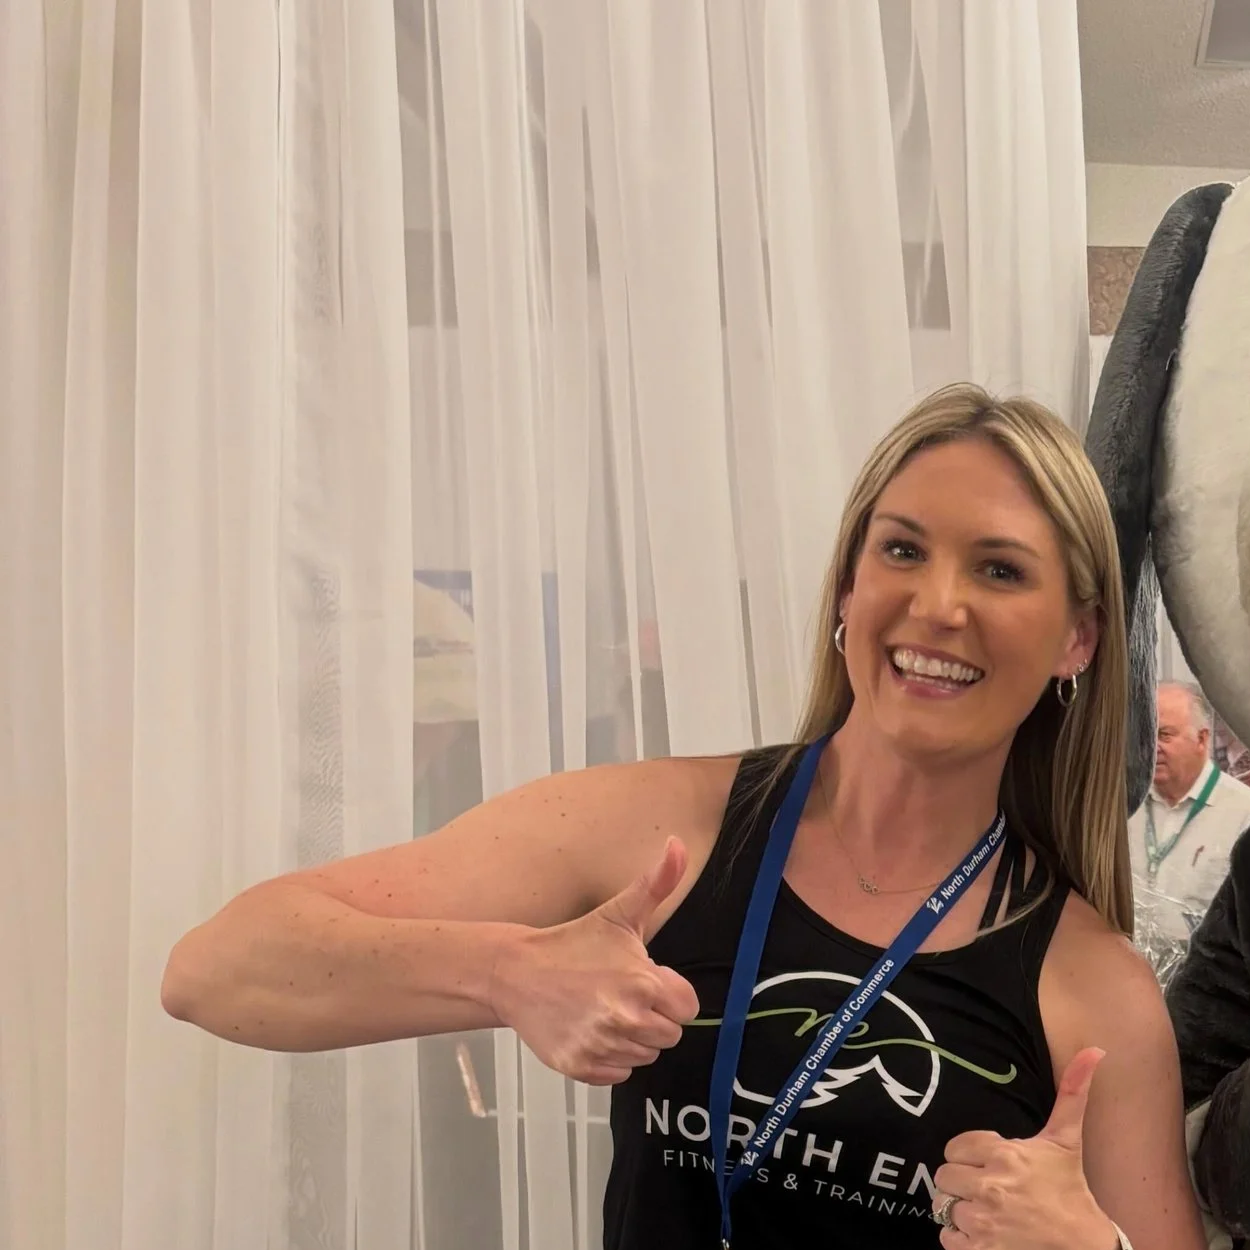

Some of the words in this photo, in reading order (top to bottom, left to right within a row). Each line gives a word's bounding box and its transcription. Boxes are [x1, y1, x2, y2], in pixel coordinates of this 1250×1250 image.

[941, 875, 964, 900] North
[962, 844, 990, 877] Durham
[754, 1117, 781, 1149] North
[775, 1071, 811, 1116] Durham
[805, 1020, 844, 1071] Chamber
[842, 1008, 854, 1023] of
[849, 959, 895, 1011] Commerce
[645, 1098, 844, 1173] NORTH
[868, 1152, 938, 1202] EN
[663, 1149, 769, 1183] FITNES
[783, 1173, 798, 1191] &
